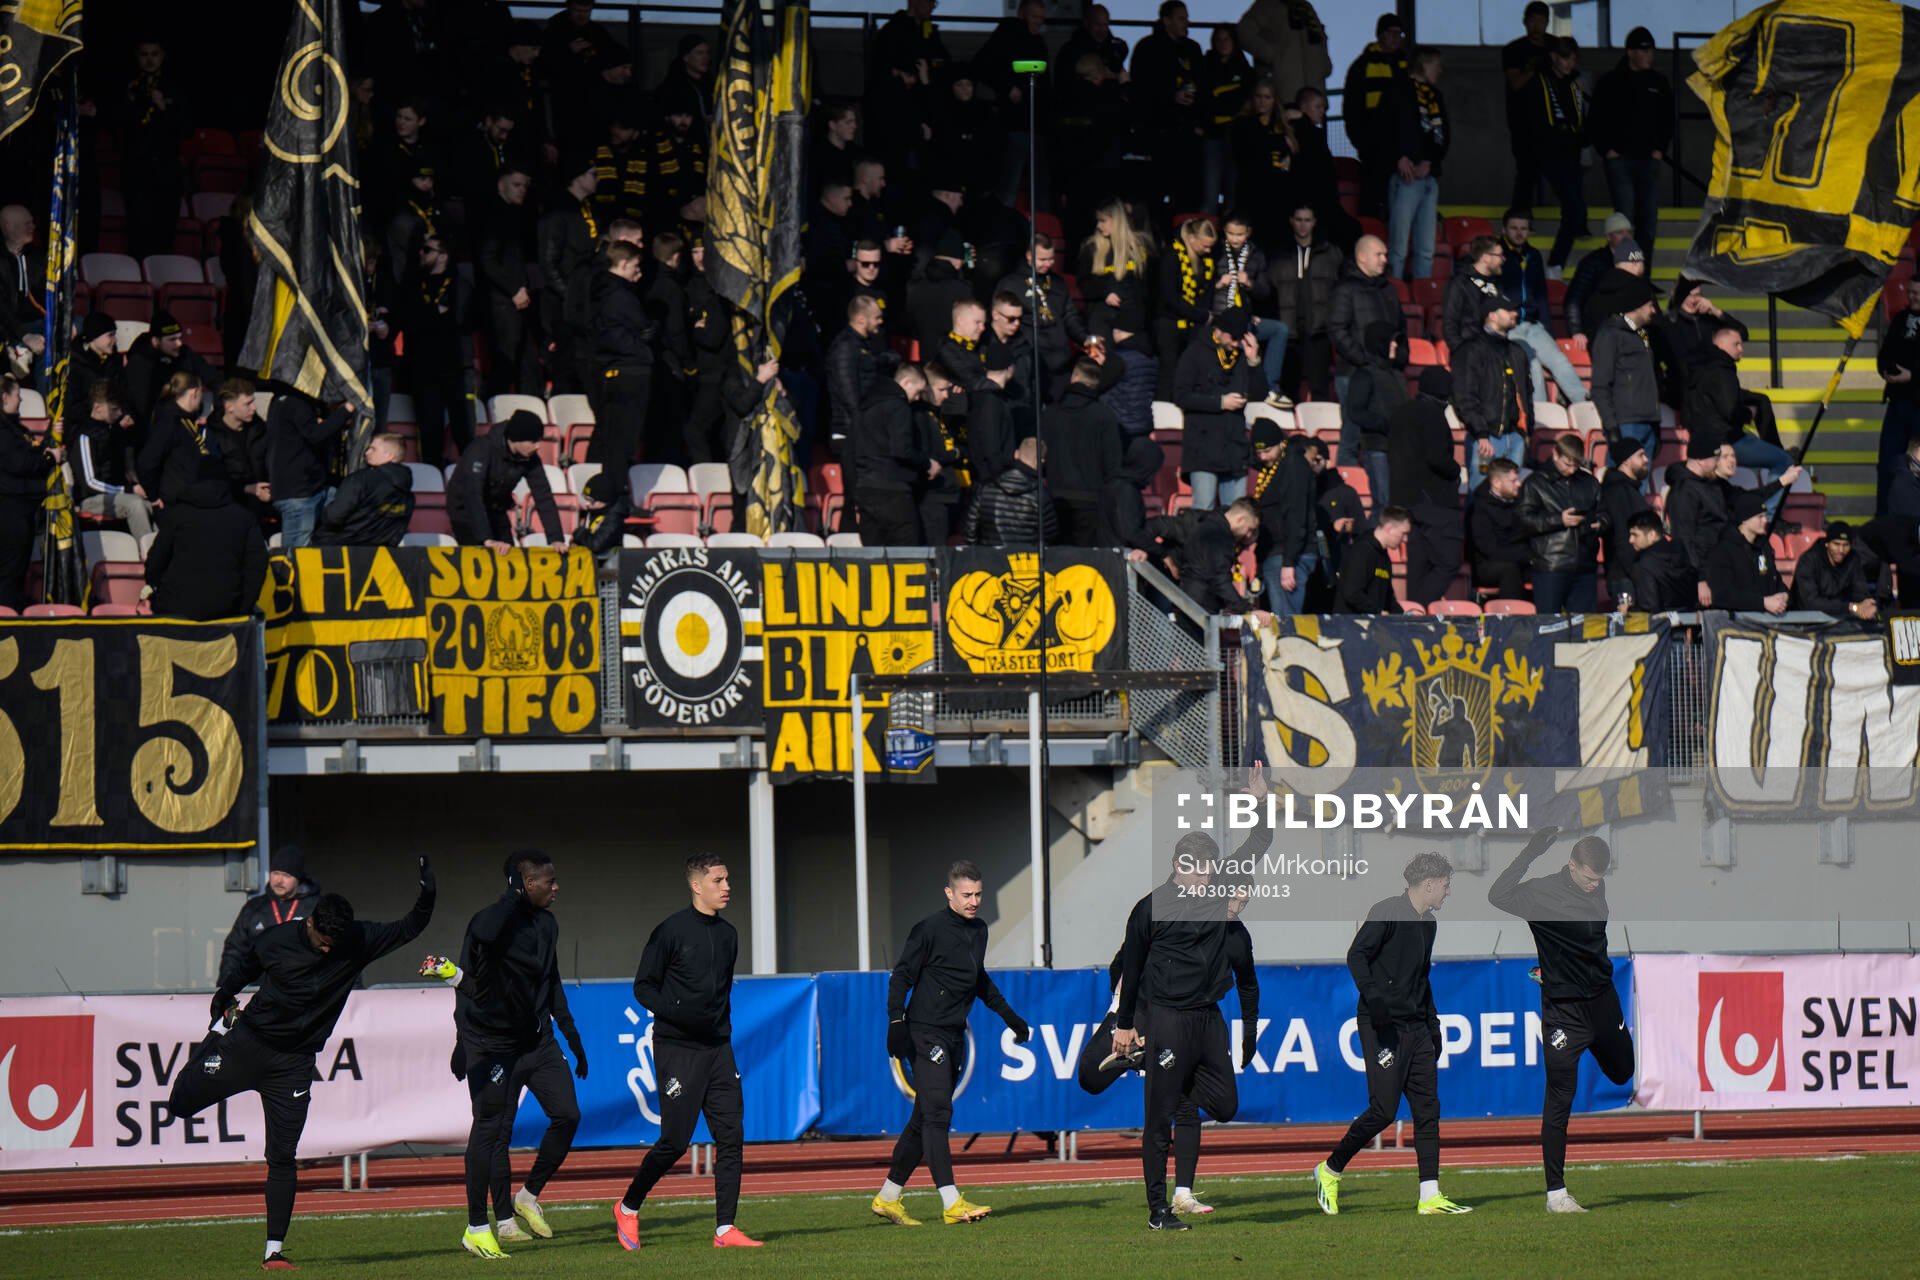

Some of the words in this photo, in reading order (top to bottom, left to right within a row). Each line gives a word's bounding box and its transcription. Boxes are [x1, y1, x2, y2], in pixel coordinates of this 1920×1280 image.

[629, 547, 709, 607] ULTRAS
[716, 560, 753, 604] AIK
[763, 562, 928, 628] LINJE
[0, 632, 244, 833] 15
[432, 675, 596, 734] TIFO
[771, 711, 882, 772] AIK
[1802, 997, 1917, 1038] SVEN
[1000, 1018, 1319, 1081] SVKA
[1802, 1050, 1908, 1091] SPEL
